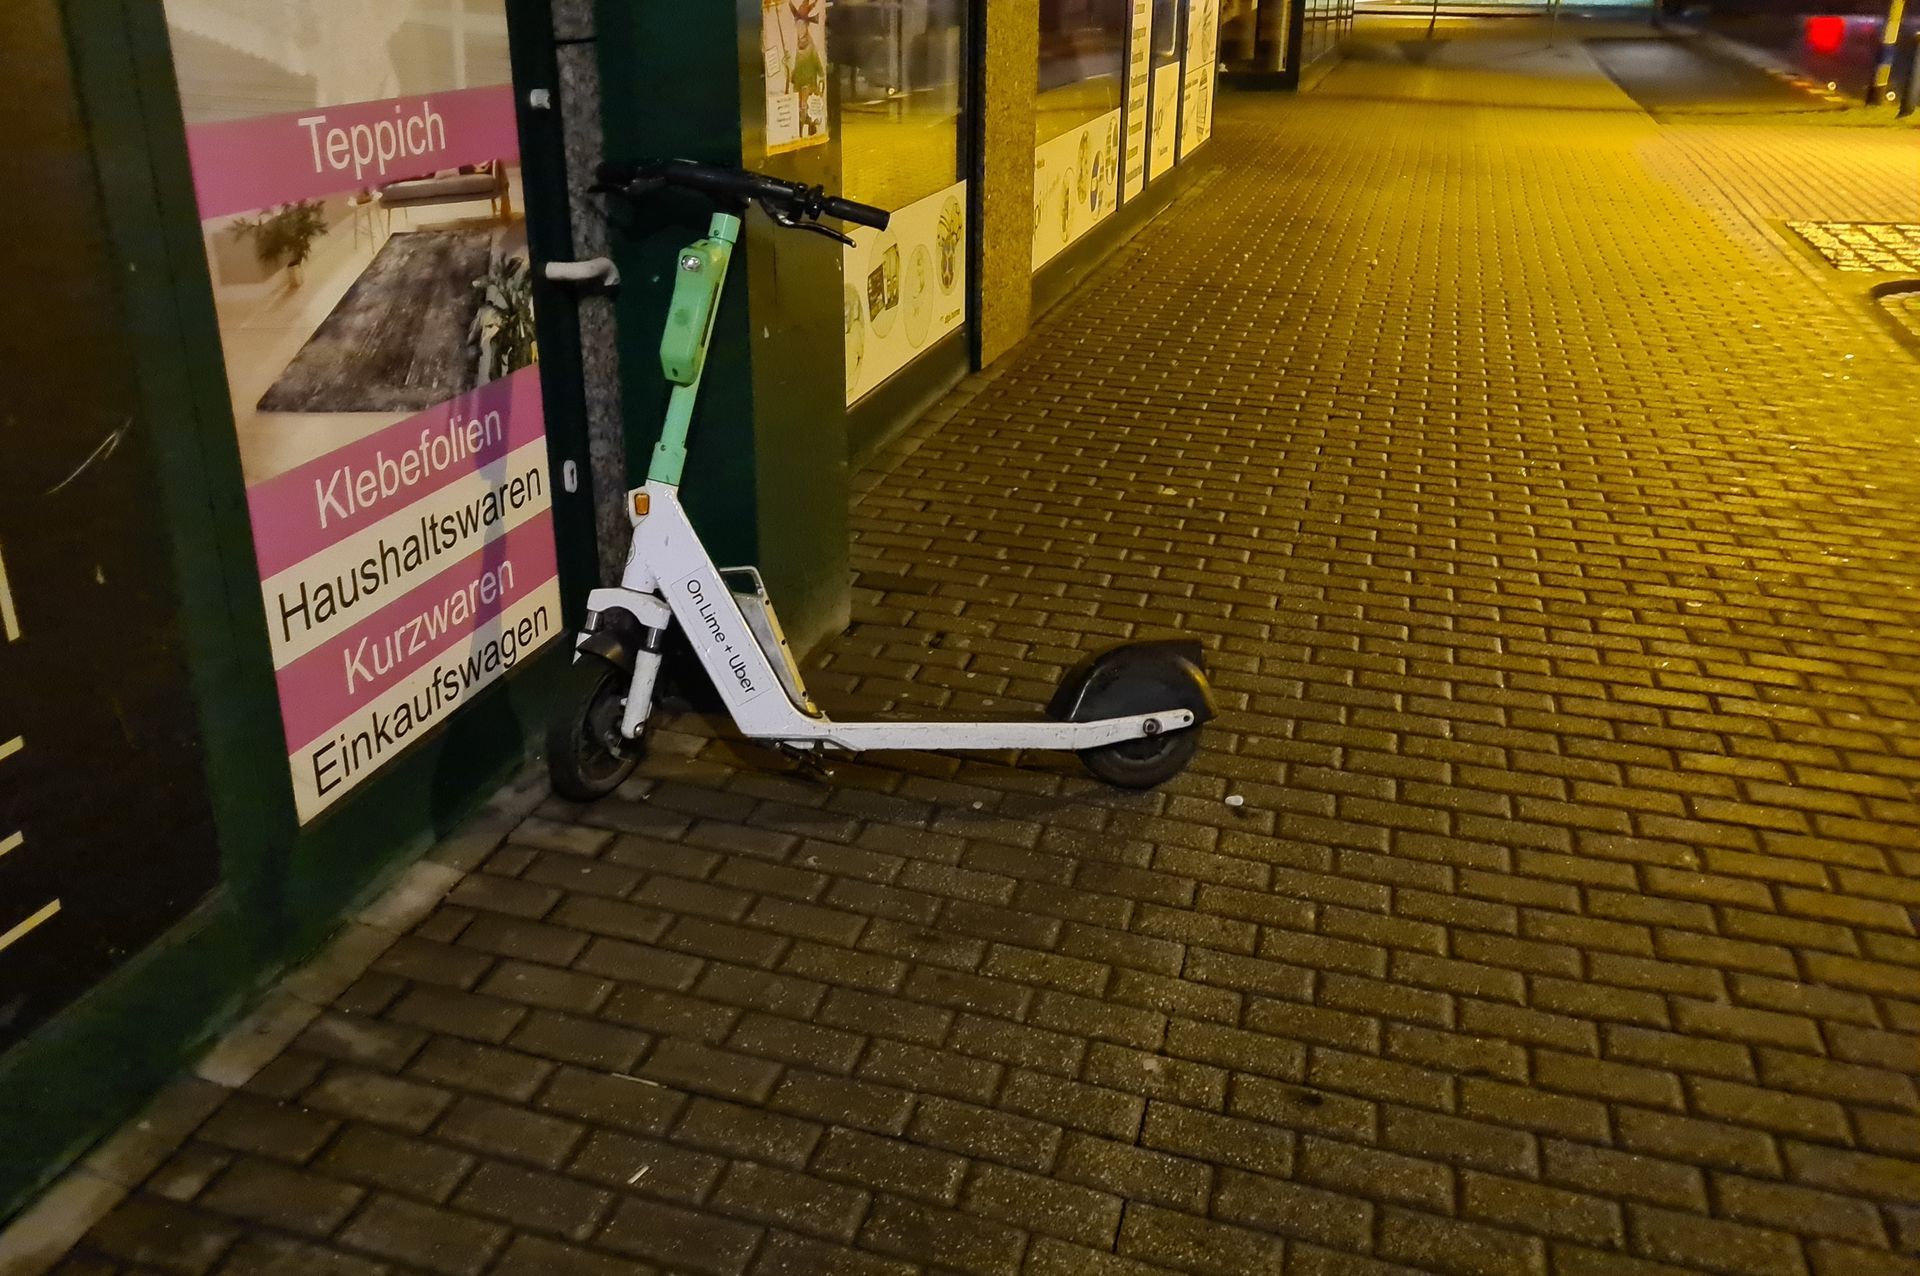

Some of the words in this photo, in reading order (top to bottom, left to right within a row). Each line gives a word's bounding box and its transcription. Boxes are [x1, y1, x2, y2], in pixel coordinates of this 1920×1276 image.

[298, 101, 446, 180] Teppich
[314, 409, 502, 529] Klebefolien
[278, 465, 541, 643] Haushaltswaren
[343, 560, 514, 695] Kurzwaren
[687, 579, 704, 605] On
[699, 603, 726, 643] Lime
[729, 654, 756, 693] Uber
[311, 605, 549, 797] Einkaufswagen
